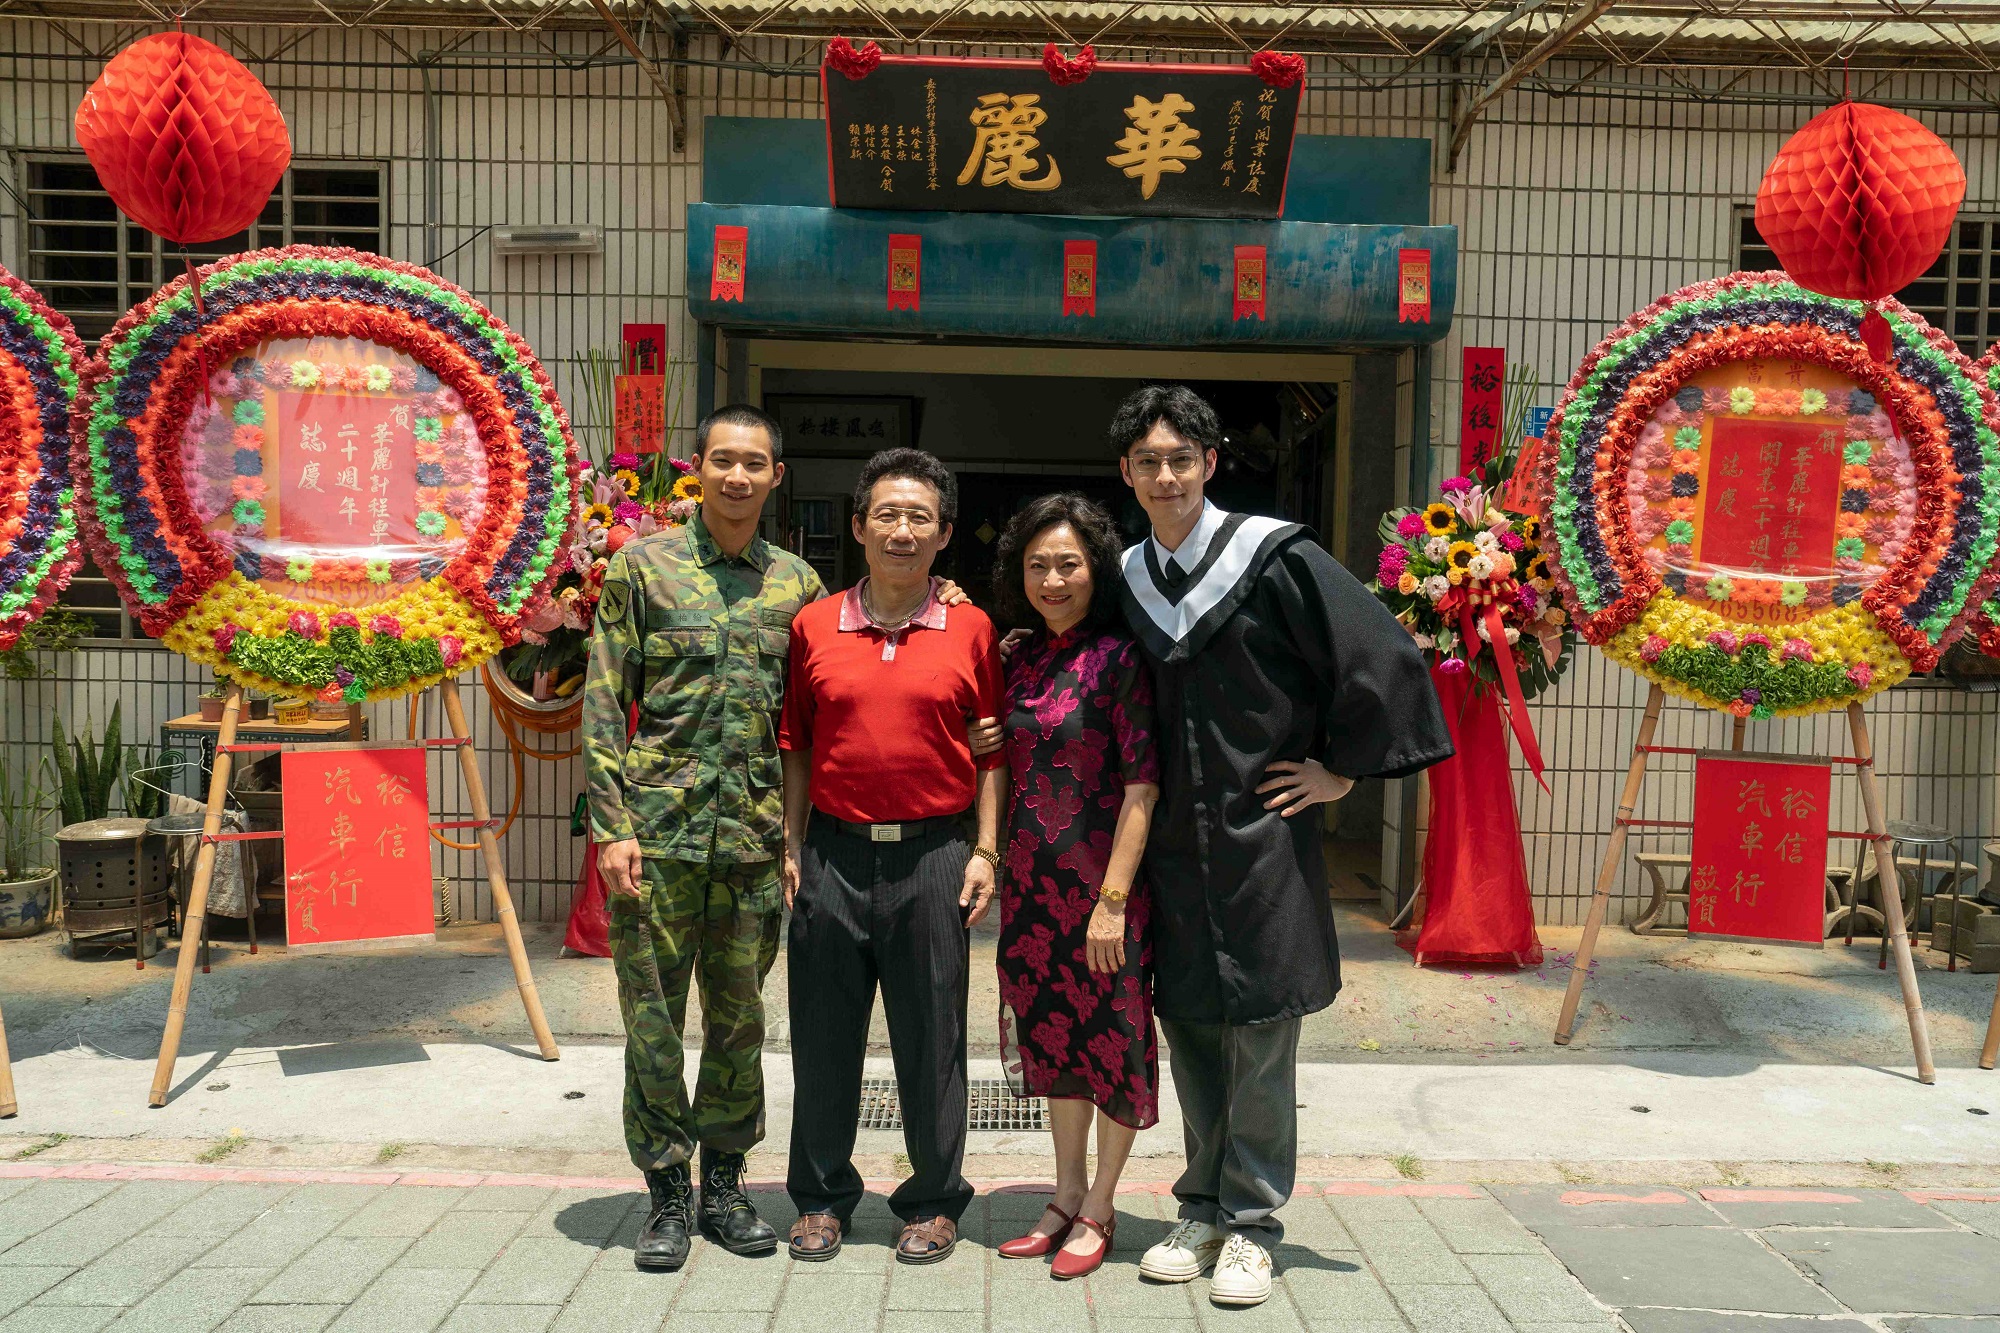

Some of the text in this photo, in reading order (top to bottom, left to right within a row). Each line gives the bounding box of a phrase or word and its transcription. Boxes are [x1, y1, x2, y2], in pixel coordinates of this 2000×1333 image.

[389, 403, 410, 430] 賀
[1468, 362, 1500, 469] 裕後光
[1814, 429, 1838, 457] 賀
[298, 421, 326, 493] 誌慶
[335, 424, 363, 525] 二十週年
[368, 422, 394, 546] 華麗計程車
[1714, 452, 1744, 518] 誌慶
[324, 767, 364, 907] 汽車行
[374, 773, 412, 859] 裕信
[1728, 779, 1772, 907] 汽車行
[1775, 787, 1817, 864] 裕信
[290, 869, 320, 935] 敬賀
[1693, 865, 1721, 927] 敬賀
